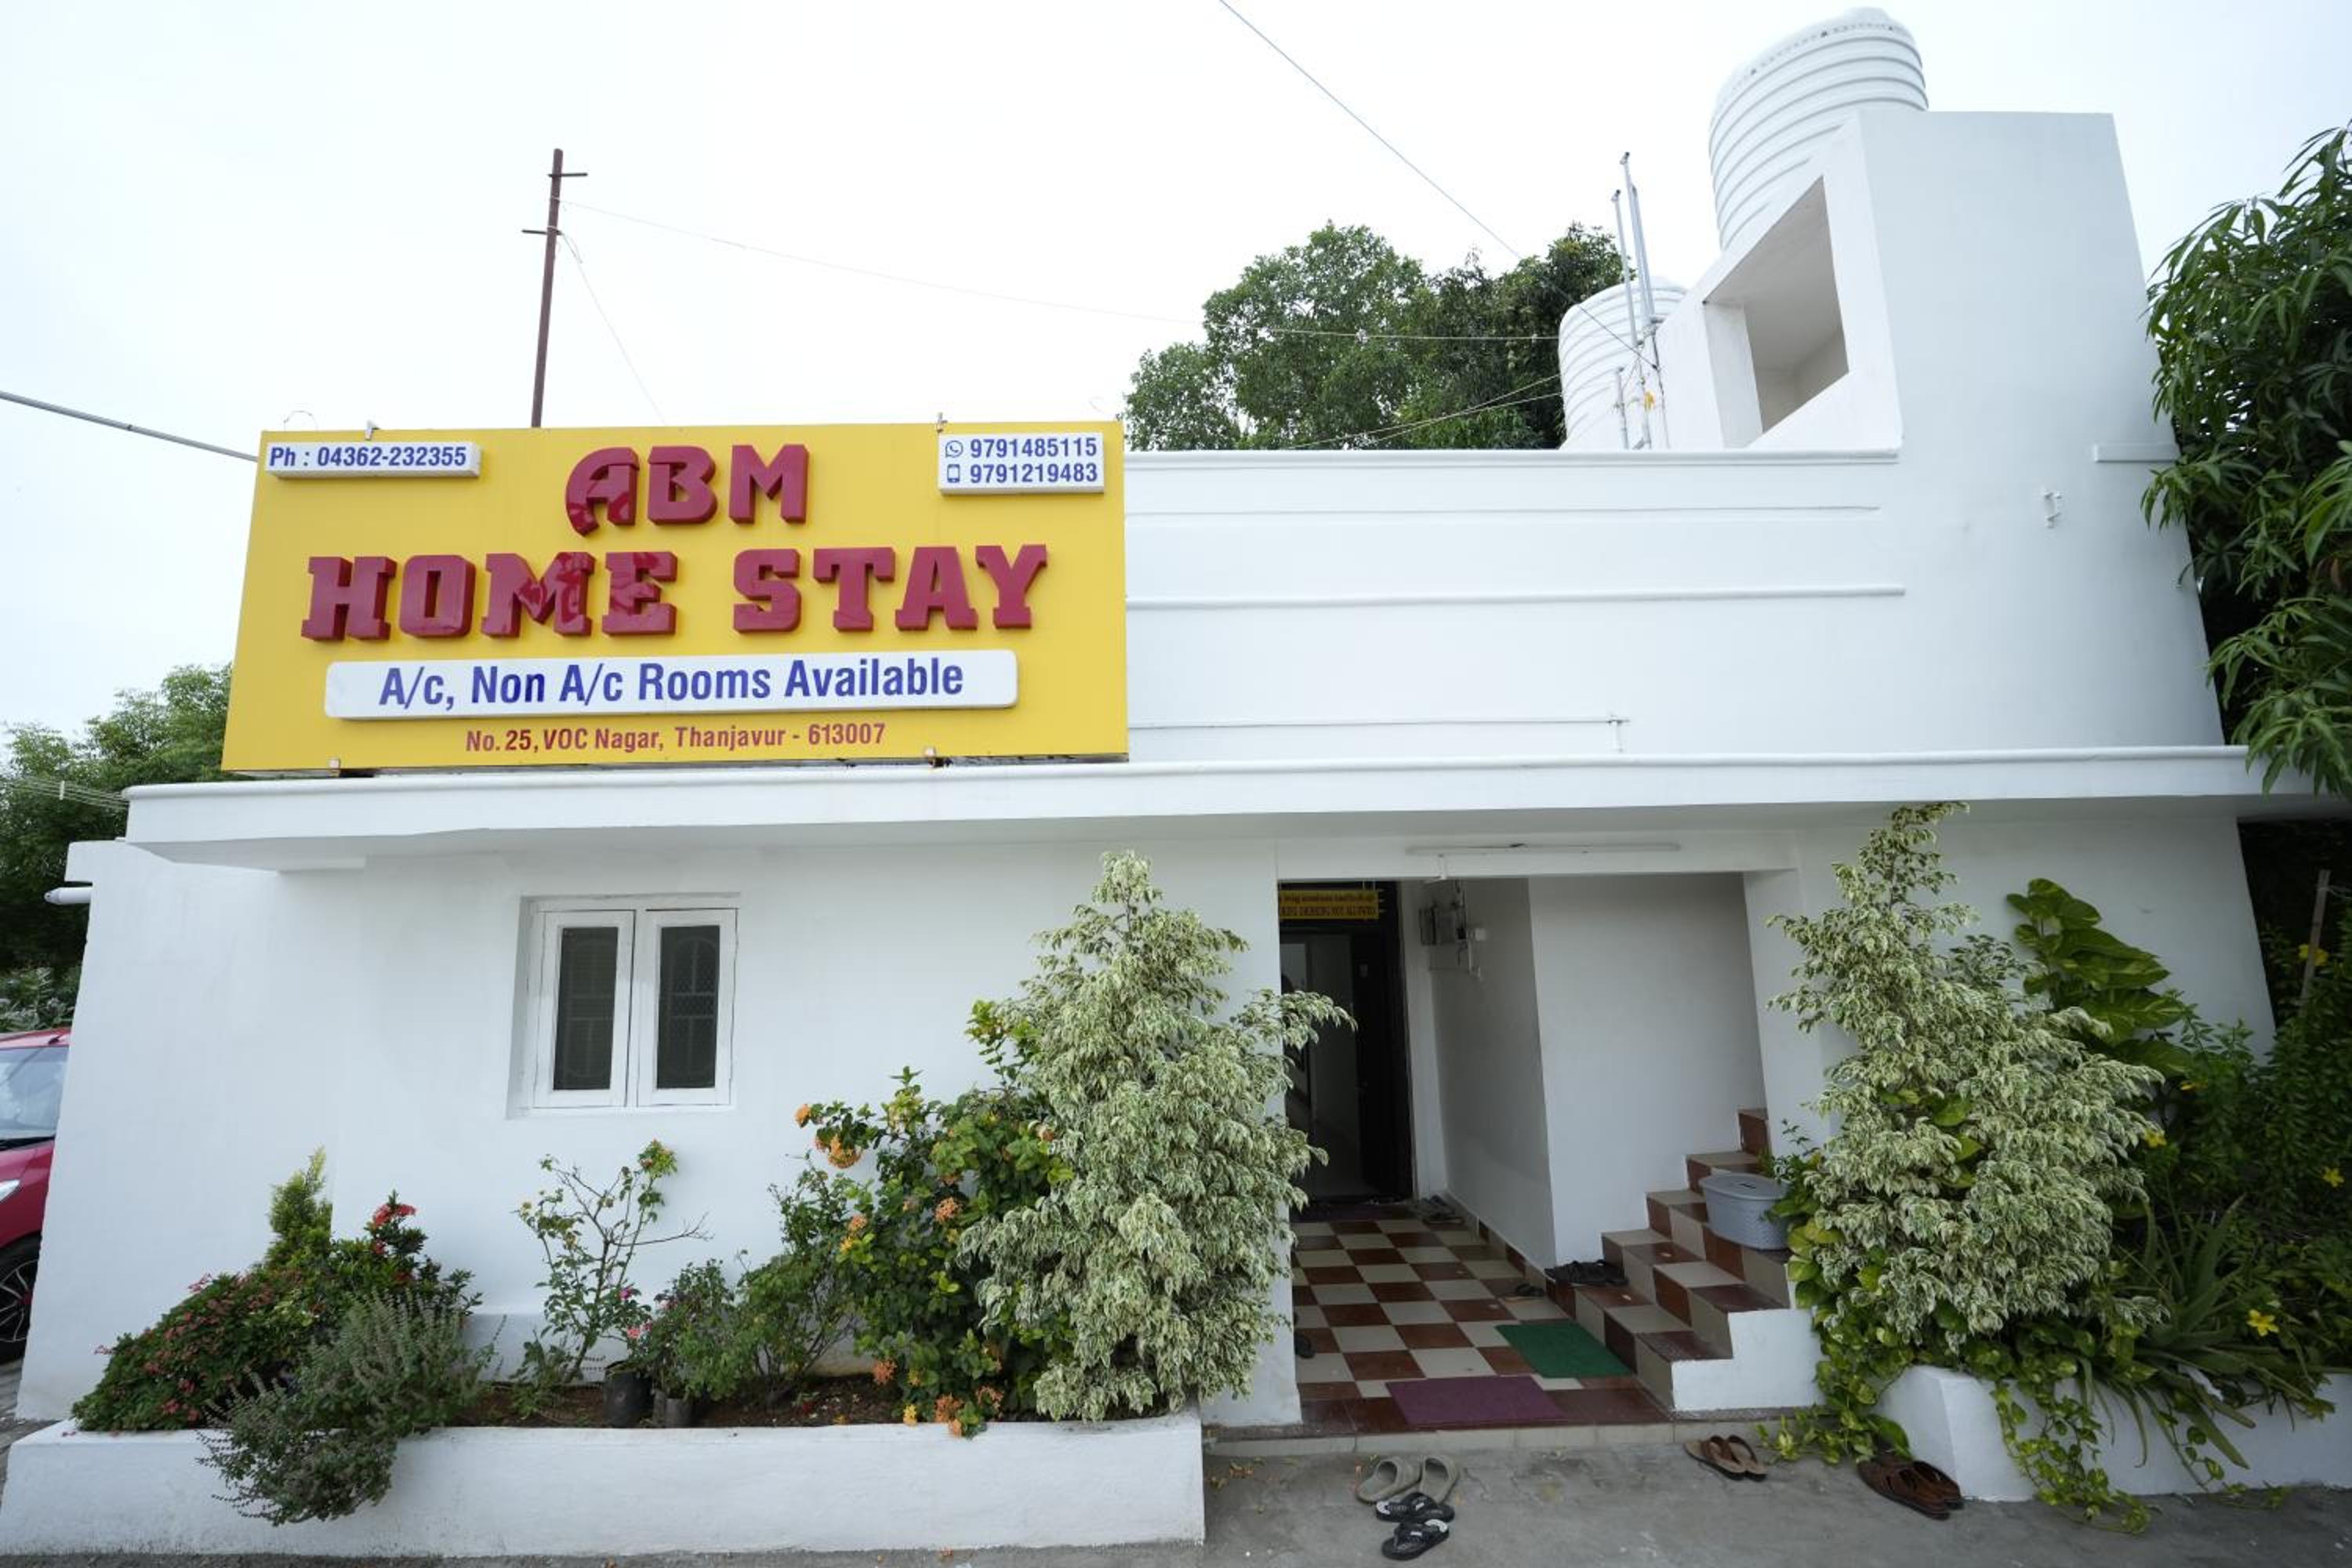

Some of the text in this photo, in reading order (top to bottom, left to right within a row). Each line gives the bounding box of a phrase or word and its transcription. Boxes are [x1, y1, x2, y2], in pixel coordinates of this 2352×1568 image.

[269, 446, 296, 467] Ph
[317, 445, 467, 467] 04362-232355
[970, 437, 1098, 459] 9791485115
[970, 462, 1098, 484] 9791219483
[565, 445, 810, 537] ABM
[301, 544, 1048, 641] HOME STAY
[378, 657, 964, 710] A/c, Non A/c Rooms Available
[594, 728, 665, 753] Nagar,
[674, 725, 786, 752] Thanjavur
[808, 722, 886, 745] 613007
